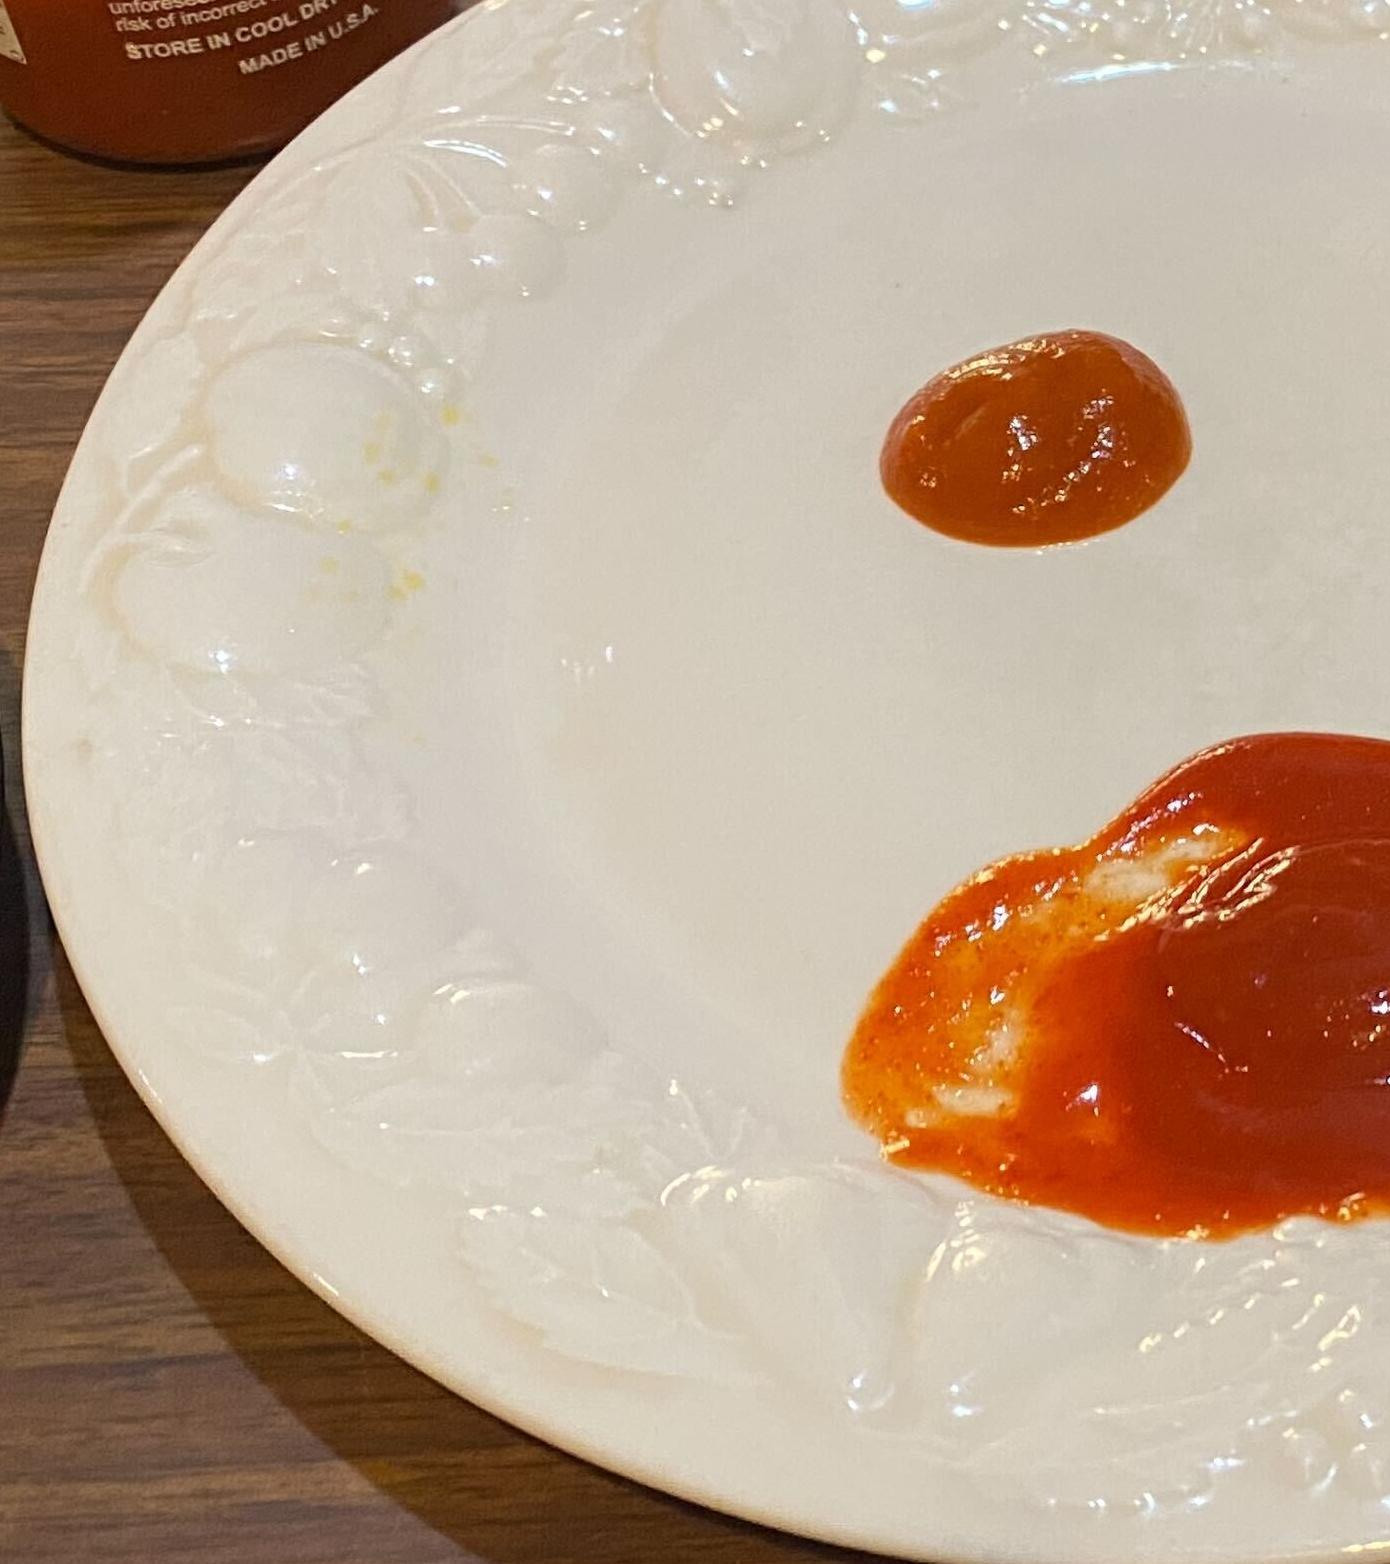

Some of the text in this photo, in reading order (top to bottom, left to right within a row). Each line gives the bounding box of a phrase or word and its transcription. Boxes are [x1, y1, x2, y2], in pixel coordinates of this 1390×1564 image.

[108, 0, 215, 14] unforese
[115, 17, 152, 32] risk
[156, 12, 176, 29] of
[125, 0, 337, 59] STORE IN COOL DR
[239, 4, 379, 74] MADE IN U.S.A.
